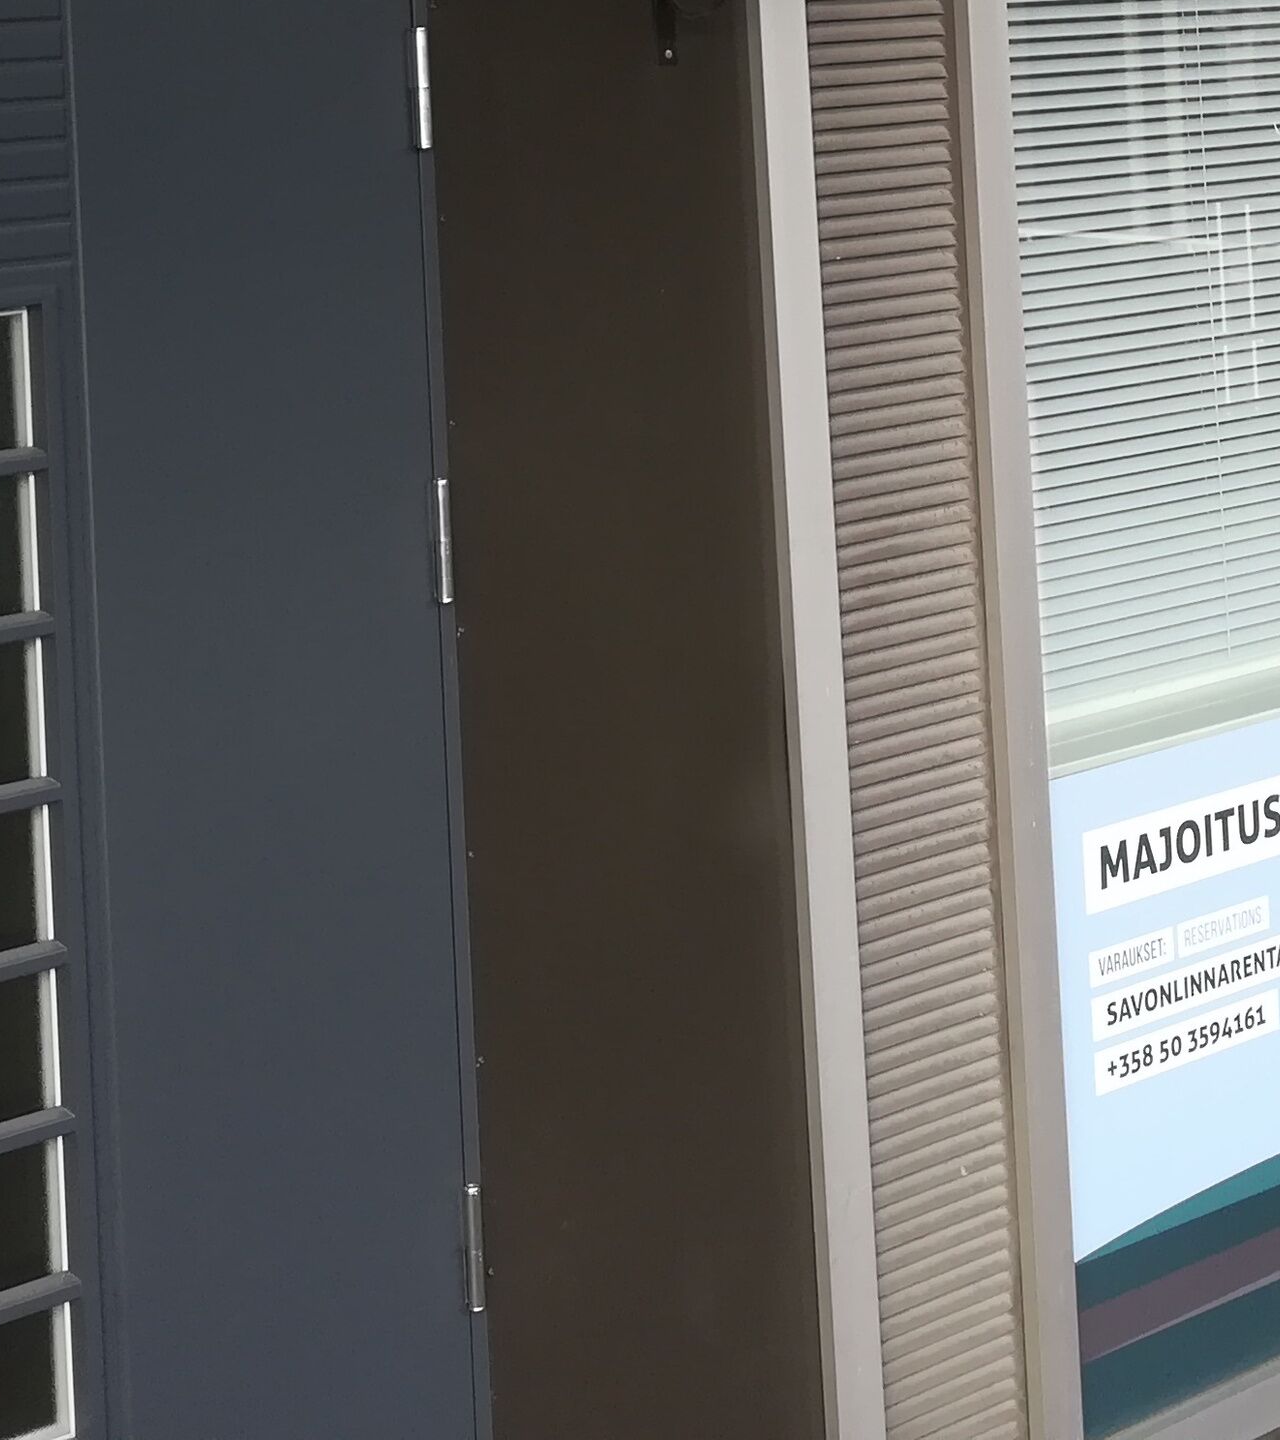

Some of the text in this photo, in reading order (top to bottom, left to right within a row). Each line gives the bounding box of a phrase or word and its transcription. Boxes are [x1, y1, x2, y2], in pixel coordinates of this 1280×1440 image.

[1183, 905, 1263, 948] RESERVATIONS
[1098, 936, 1167, 977] VARAUKSET:
[1106, 1005, 1267, 1078] +358 50 3594161
